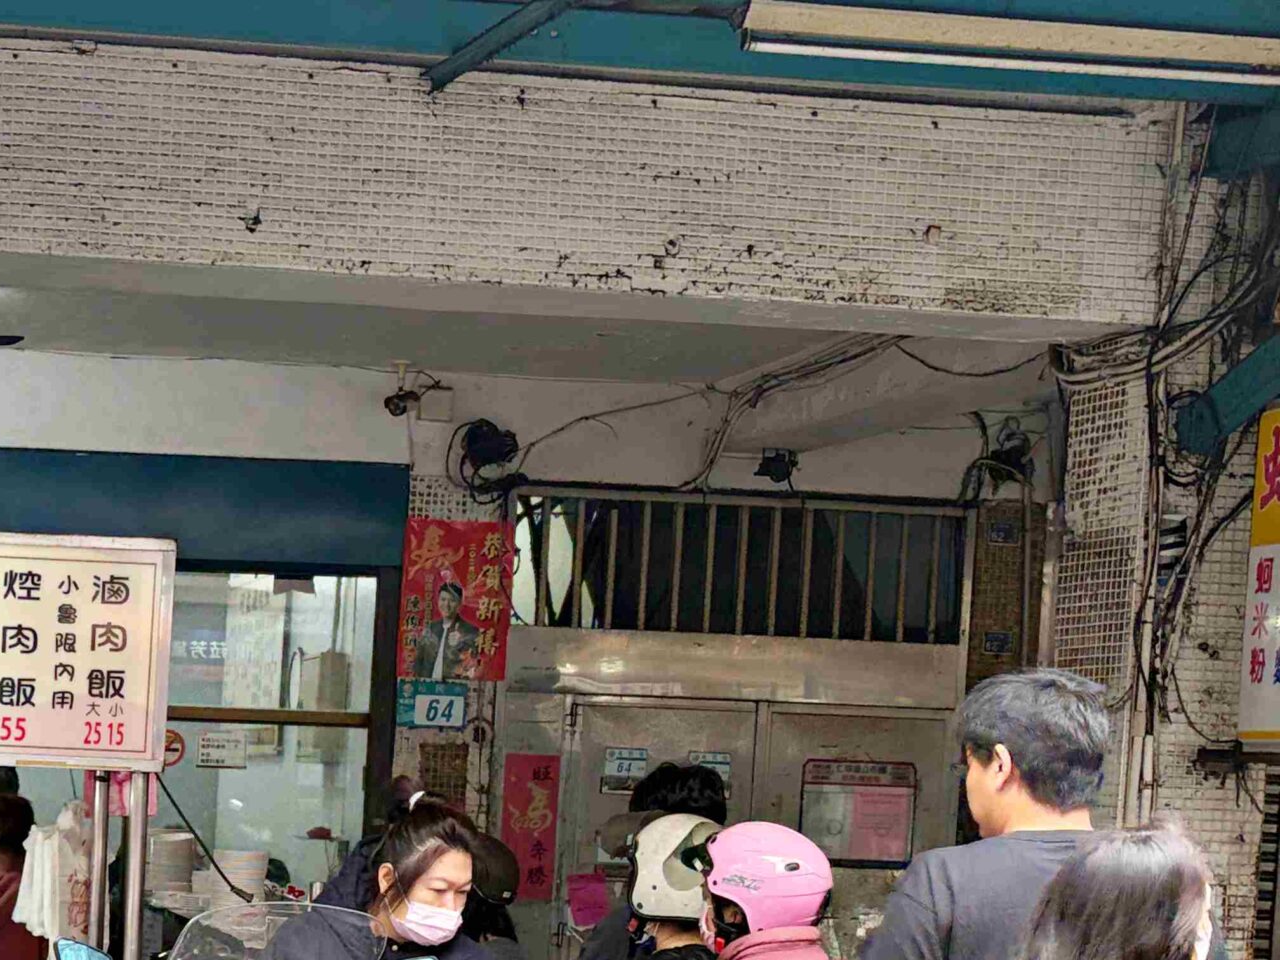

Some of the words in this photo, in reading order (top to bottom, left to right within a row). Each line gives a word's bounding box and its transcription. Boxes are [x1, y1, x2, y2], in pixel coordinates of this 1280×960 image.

[1249, 556, 1275, 685] 蚵米粉
[86, 574, 131, 699] 滷肉飯
[425, 698, 455, 723] 64
[0, 716, 27, 742] 55
[83, 720, 102, 746] 25
[107, 721, 125, 747] 15
